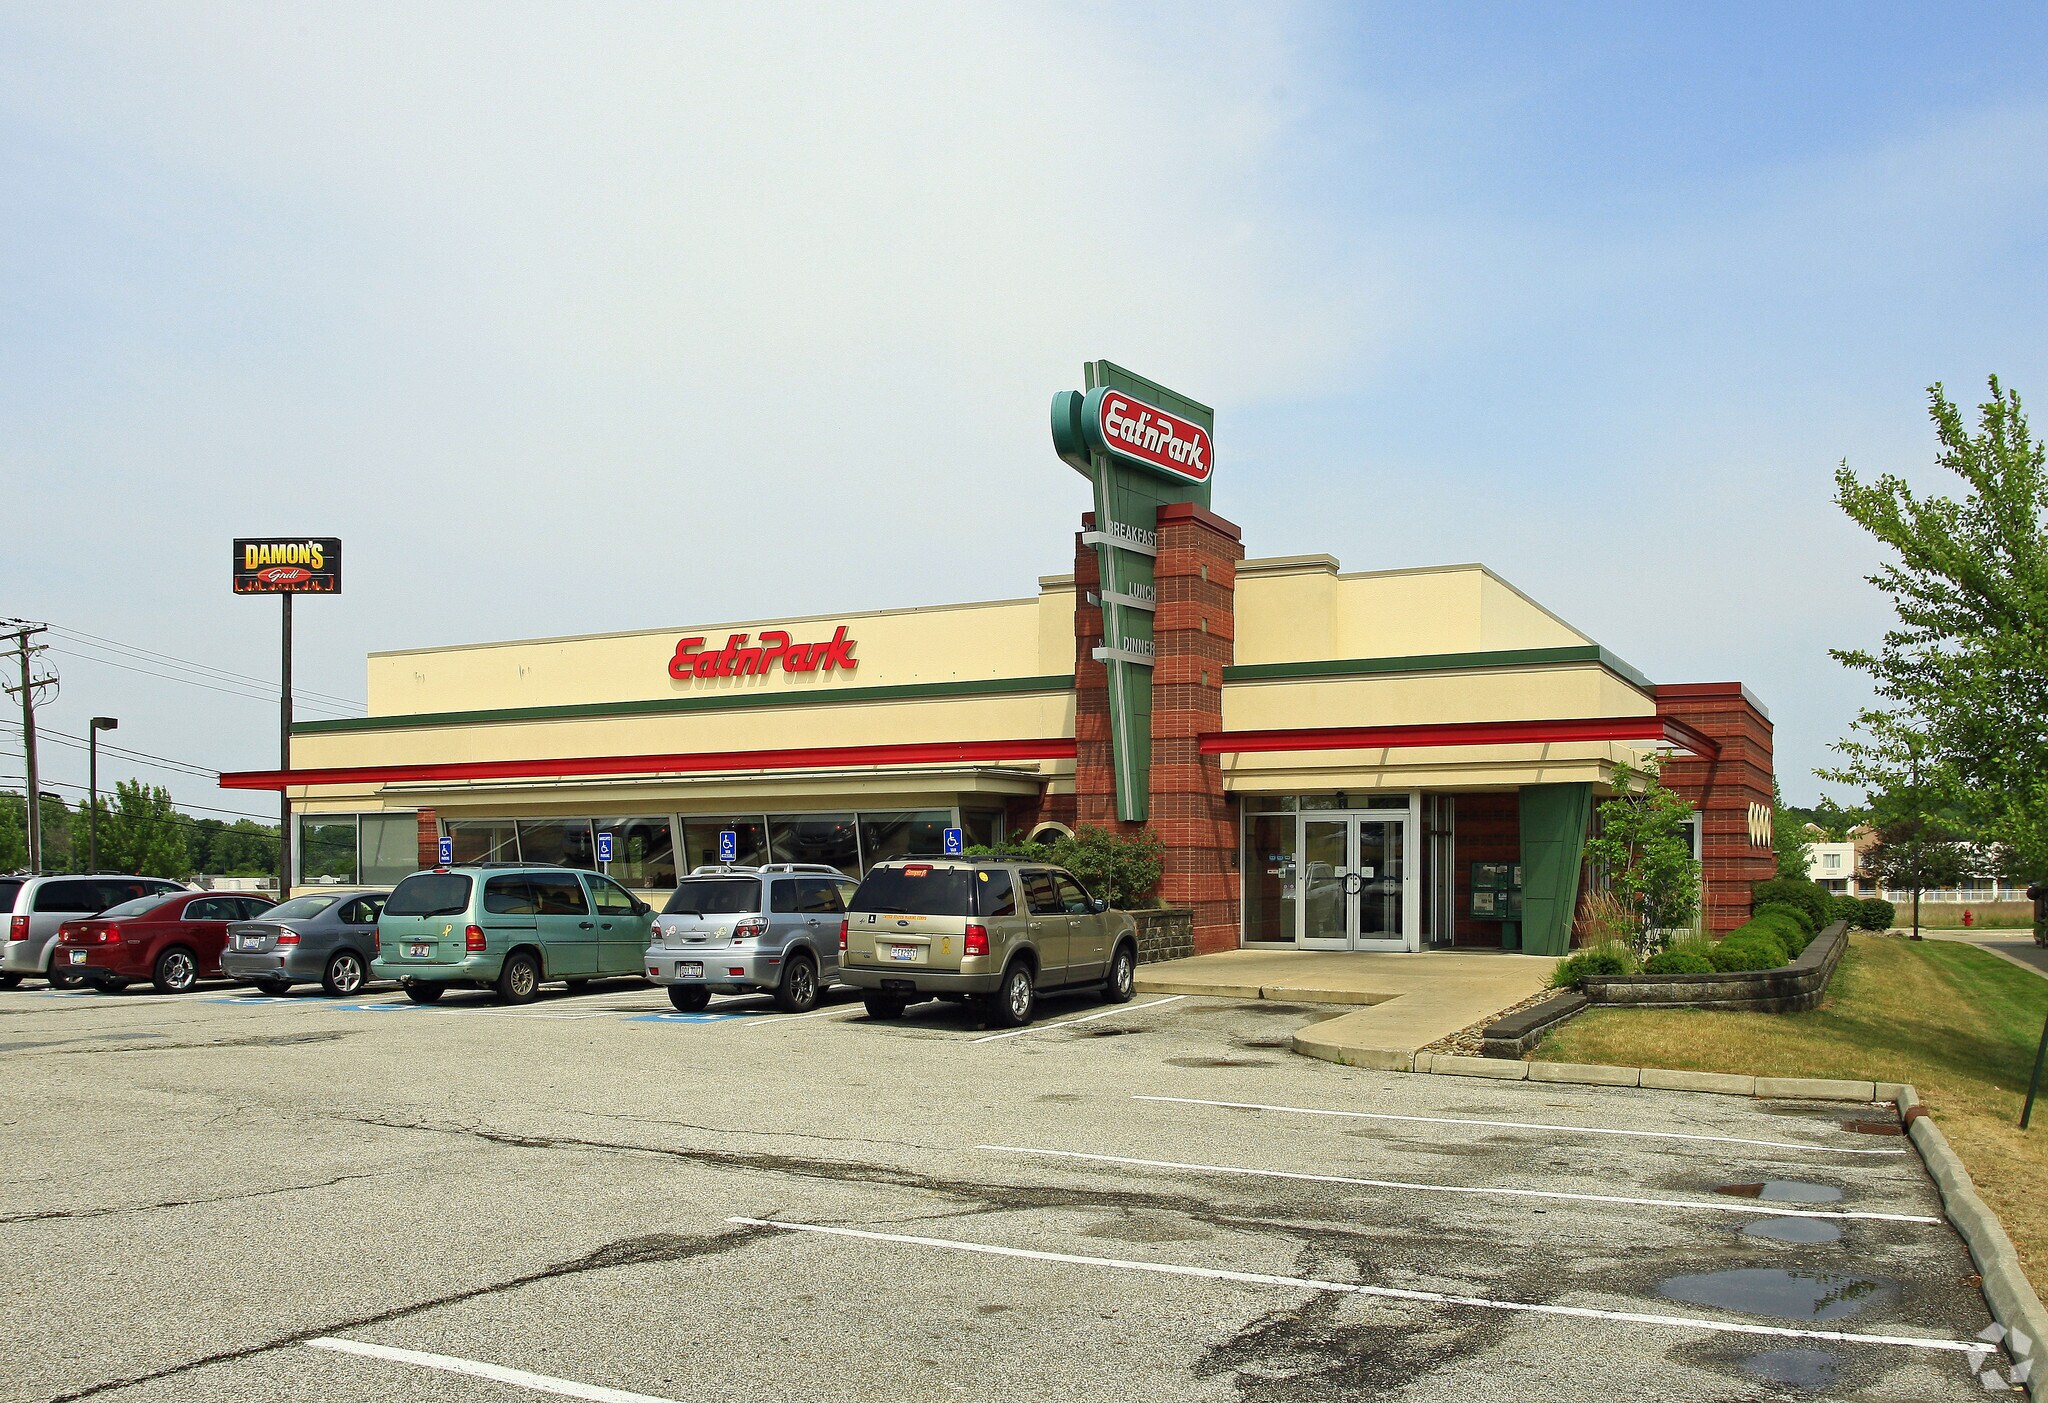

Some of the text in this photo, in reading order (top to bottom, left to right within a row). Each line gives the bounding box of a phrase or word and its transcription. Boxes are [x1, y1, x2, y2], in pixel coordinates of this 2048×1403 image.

[1108, 520, 1158, 547] BREAKFAST
[245, 541, 324, 569] DAMON'S
[267, 569, 299, 582] Grill
[1129, 581, 1157, 602] LUNCH
[1123, 636, 1156, 657] DINNER
